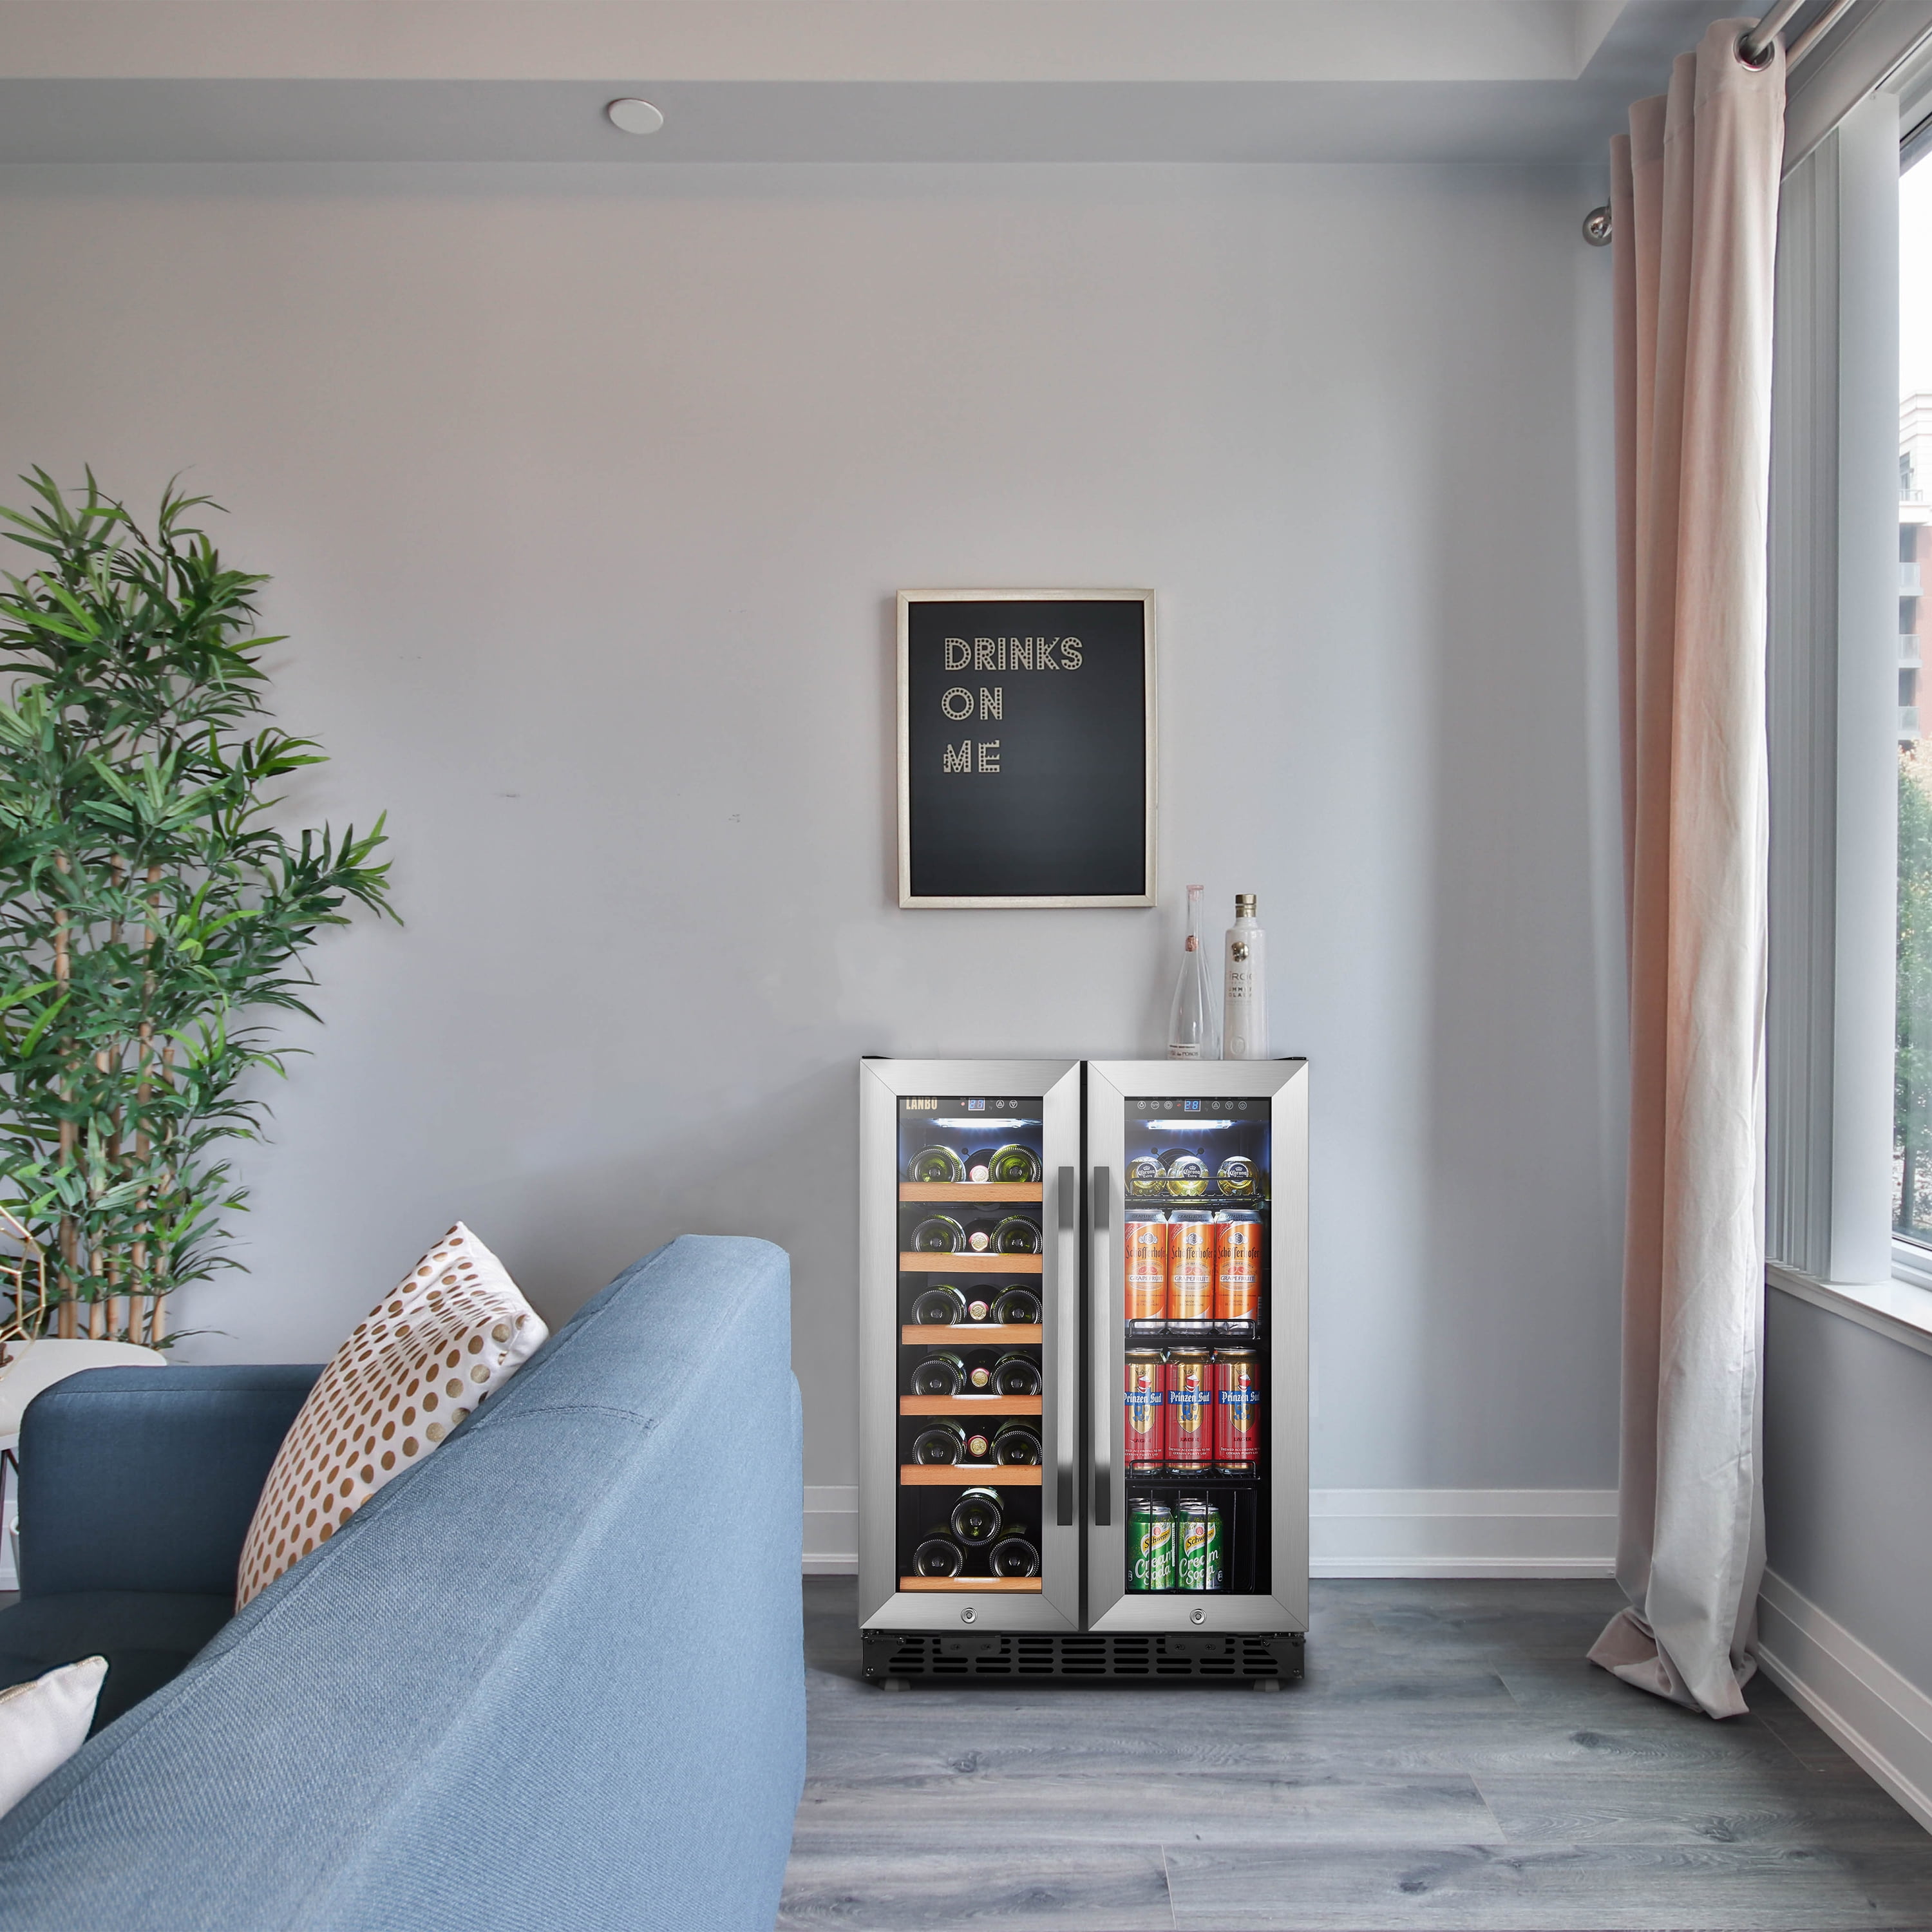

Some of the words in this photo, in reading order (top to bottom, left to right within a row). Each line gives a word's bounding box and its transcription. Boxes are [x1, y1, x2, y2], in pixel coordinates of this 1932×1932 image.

[945, 637, 1083, 670] DRINKS
[942, 687, 1003, 720] ON
[943, 740, 1000, 773] ME
[906, 1097, 938, 1110] LANBO
[1185, 1101, 1198, 1110] 28
[1126, 1245, 1166, 1259] Schöfferhofer
[1171, 1245, 1213, 1260] Schöfferhofer
[1218, 1245, 1260, 1260] Schöfferhofer
[1170, 1391, 1197, 1403] Prinzen
[1222, 1392, 1249, 1403] Prinzen
